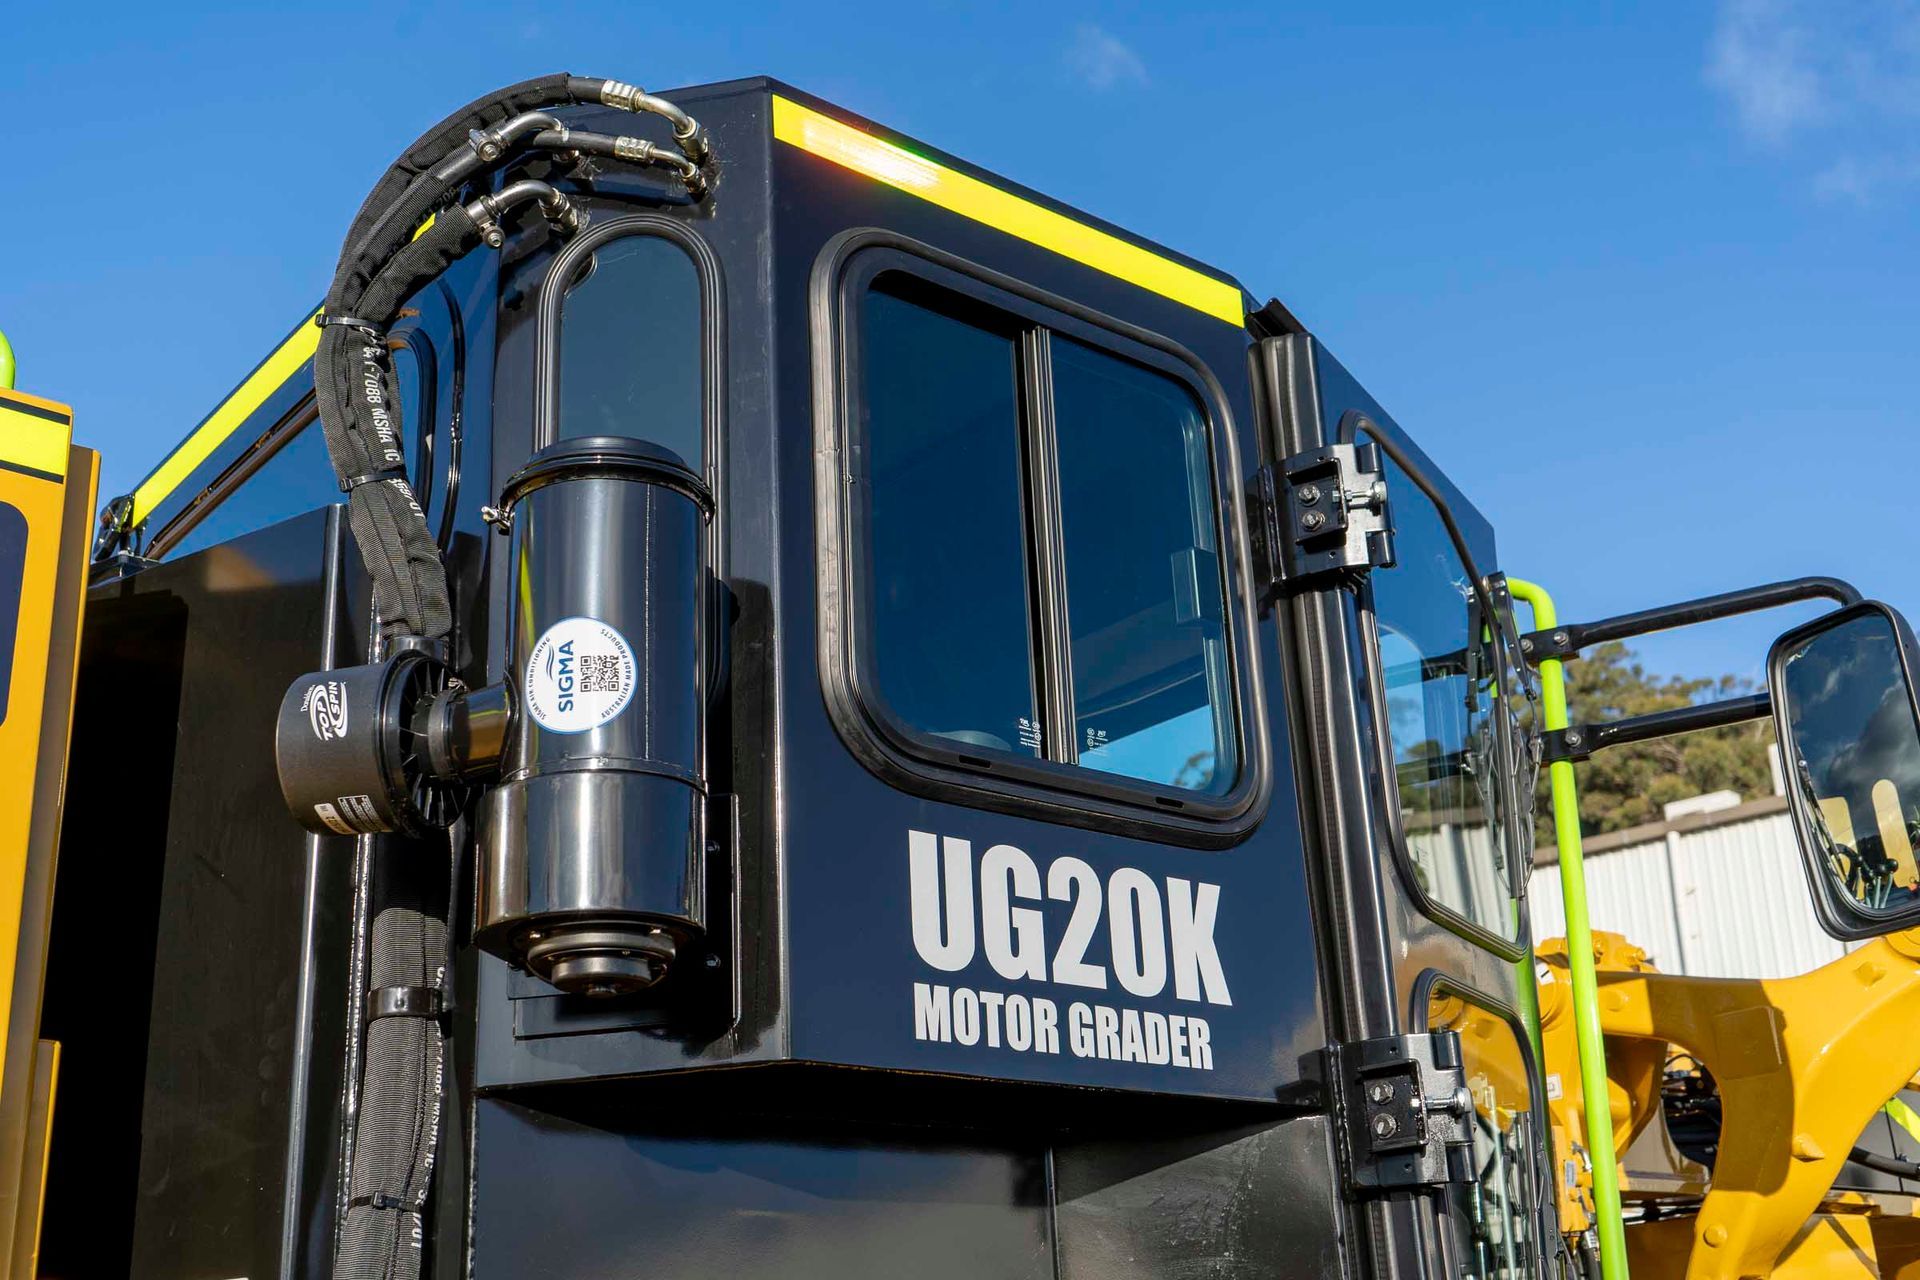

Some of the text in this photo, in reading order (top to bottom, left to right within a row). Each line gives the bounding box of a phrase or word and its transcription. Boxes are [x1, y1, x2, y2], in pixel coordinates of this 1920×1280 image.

[371, 408, 393, 443] MSHA
[385, 449, 400, 461] IC
[328, 681, 341, 715] SPIN
[528, 636, 551, 721] SIGMA AIR CONDITIONING
[558, 640, 574, 713] SIGMA
[600, 628, 632, 719] AUSTRALIAN MADE PRODUCTS
[317, 701, 333, 741] TOP
[908, 829, 1233, 1006] UG20K
[913, 982, 1214, 1071] MOTOR GRADER
